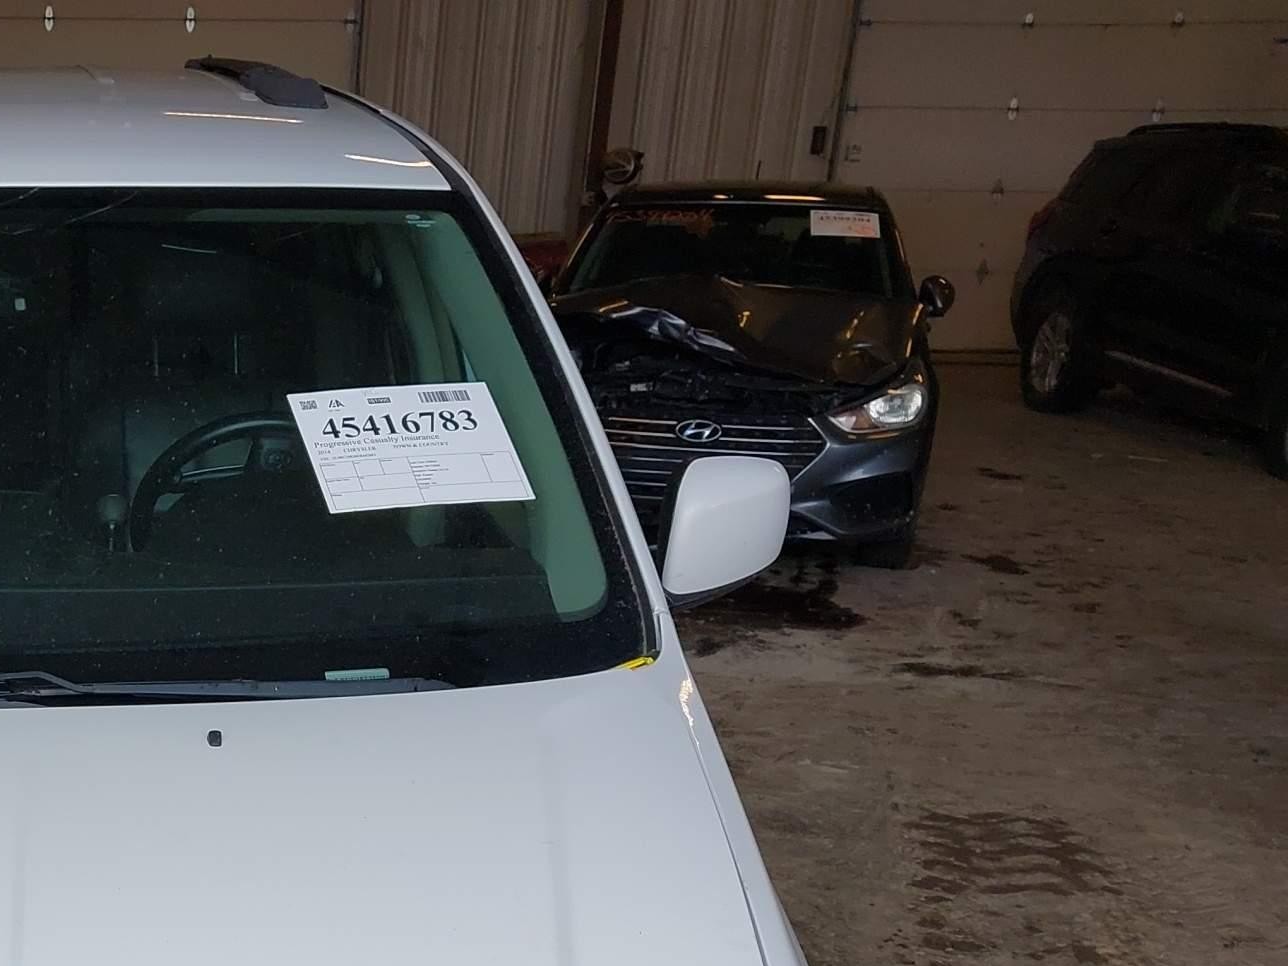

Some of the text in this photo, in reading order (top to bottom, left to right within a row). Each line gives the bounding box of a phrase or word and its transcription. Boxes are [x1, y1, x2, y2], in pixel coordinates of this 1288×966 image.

[322, 409, 478, 439] 45416783
[314, 434, 441, 449] Progressive Casualty Insurance
